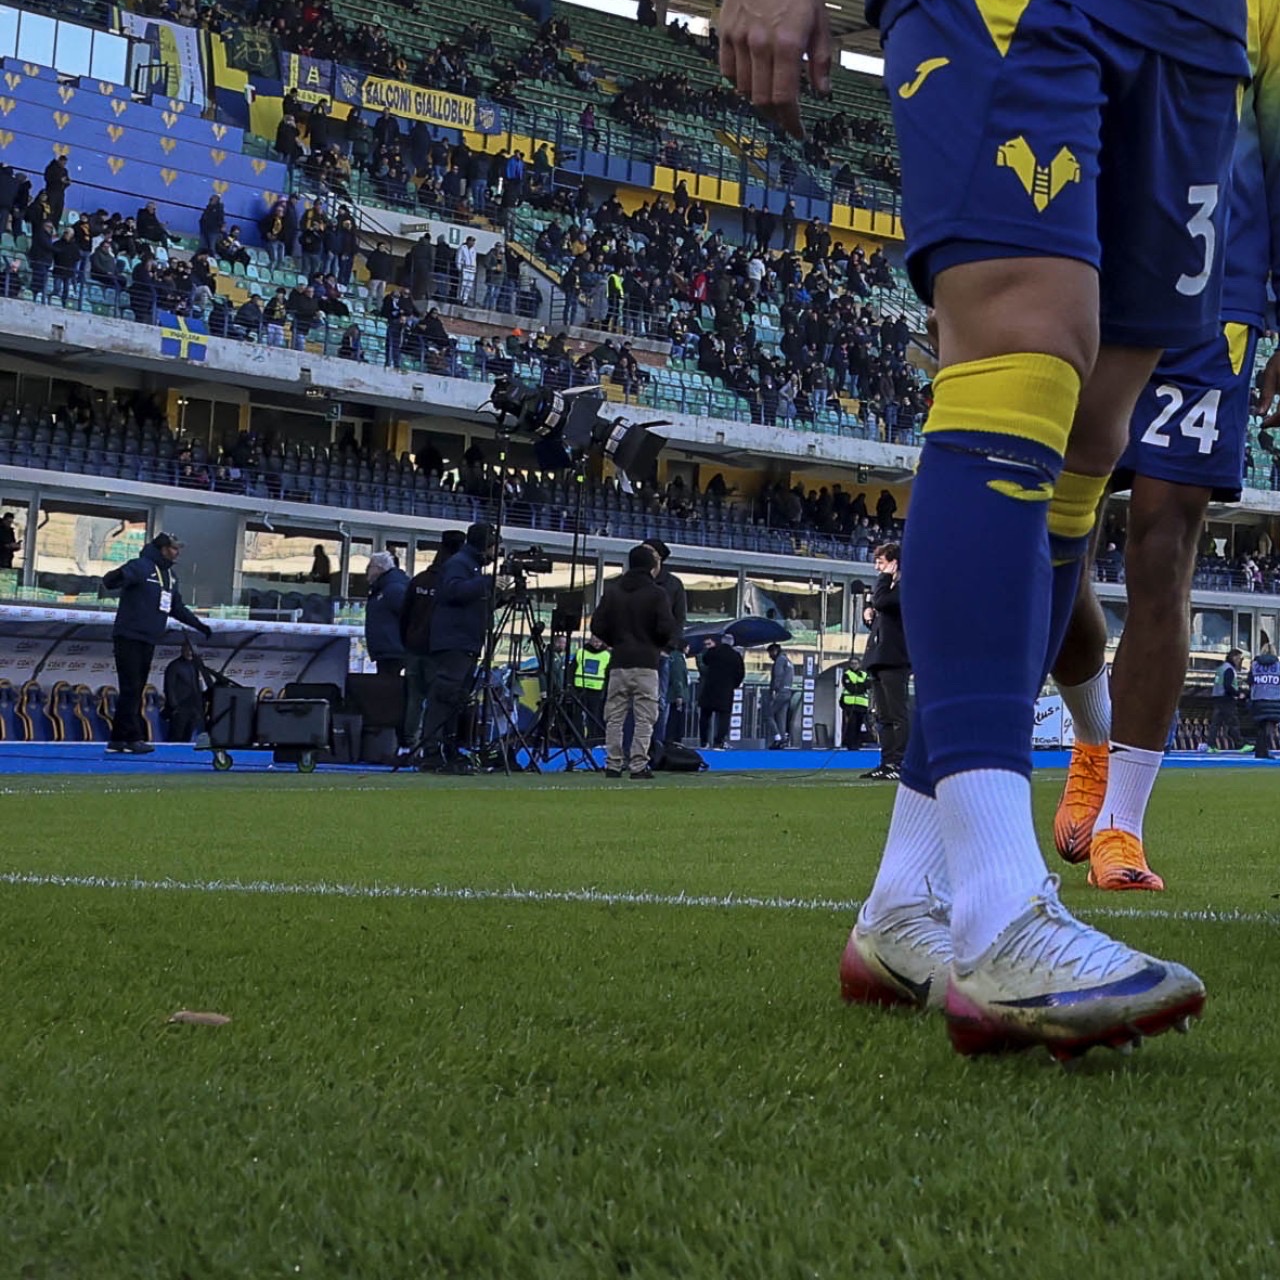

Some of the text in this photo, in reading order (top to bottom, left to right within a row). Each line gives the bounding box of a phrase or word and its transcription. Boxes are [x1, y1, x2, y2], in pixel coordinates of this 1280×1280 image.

[414, 91, 472, 127] GIALLOBLU
[1175, 184, 1218, 296] 3
[1140, 384, 1222, 455] 24
